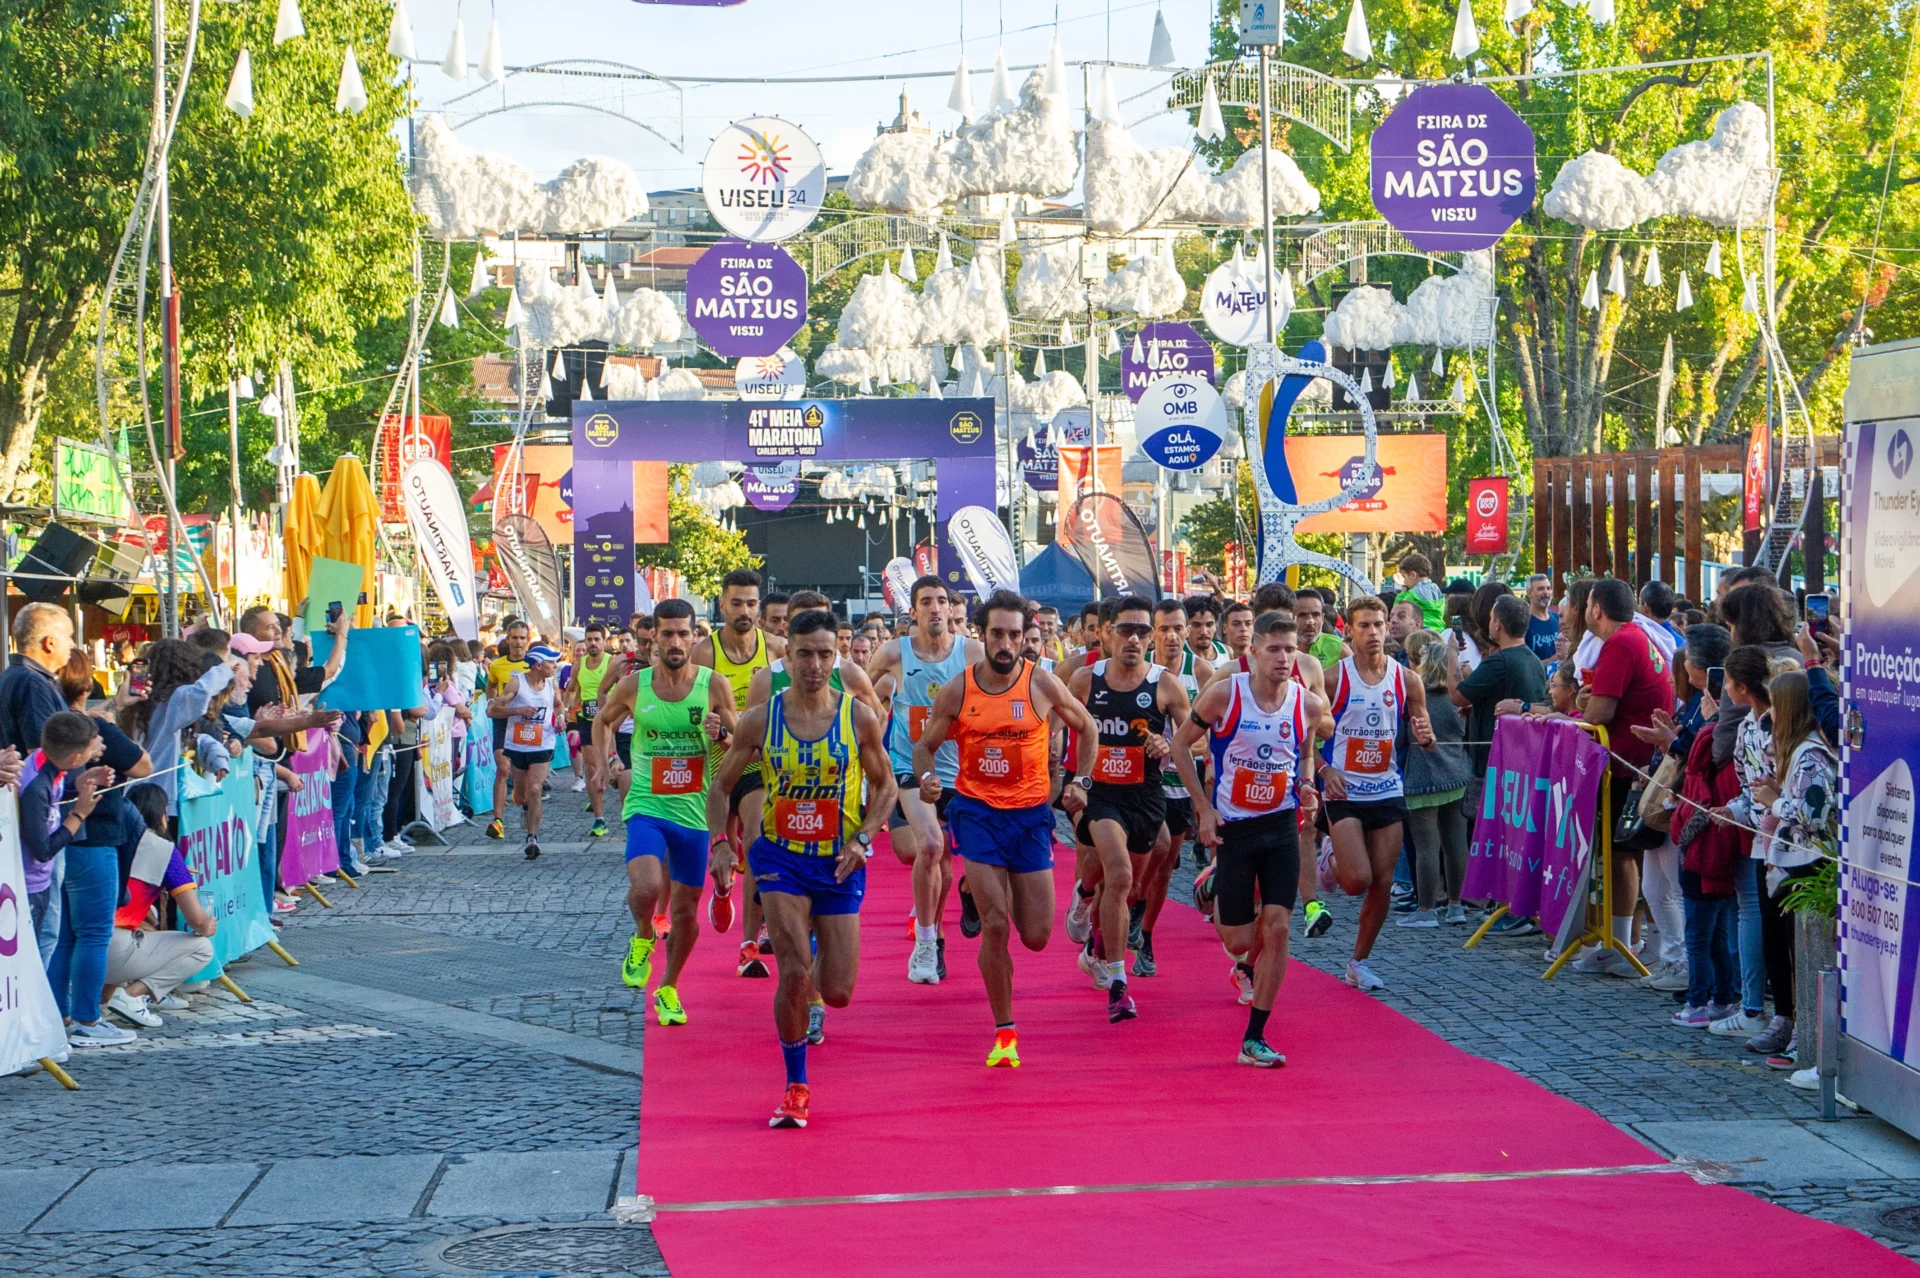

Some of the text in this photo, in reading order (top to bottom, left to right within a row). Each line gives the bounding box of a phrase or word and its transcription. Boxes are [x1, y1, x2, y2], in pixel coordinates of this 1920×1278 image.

[1417, 114, 1488, 129] FEIRA DE
[1417, 133, 1488, 167] SÃO
[1384, 169, 1523, 198] MATEUS
[720, 189, 784, 208] VISEU
[1431, 207, 1477, 221] VISEU
[720, 258, 773, 269] FEIRA DE
[720, 272, 773, 296] SÃO
[1217, 281, 1277, 317] MATEU
[695, 298, 798, 319] MATEUS
[729, 326, 764, 336] VISEU
[1147, 339, 1174, 348] FIRA
[745, 383, 782, 395] VISEU
[1163, 401, 1198, 415] OMB
[770, 409, 804, 427] MEIA
[749, 428, 822, 447] MARATONA
[1168, 430, 1196, 444] OLÁ,
[756, 447, 777, 456] CARLOS
[778, 447, 795, 455] LOPES
[799, 447, 816, 455] VISEU
[1164, 445, 1201, 454] ESTAMOS
[1168, 455, 1190, 464] AQUI
[1874, 489, 1920, 515] Thunder Ey
[1855, 686, 1920, 712] em qualquer luga
[978, 757, 1009, 773] 2006
[1356, 750, 1382, 764] 2025
[1102, 758, 1132, 774] 2032
[662, 769, 692, 785] 2009
[1245, 783, 1275, 800] 1020
[1885, 781, 1911, 801] Sistema
[787, 813, 824, 830] 2034
[1862, 824, 1906, 846] para qualquer
[1851, 868, 1899, 902] Aluga-se:
[1851, 898, 1899, 932] 800 507 050
